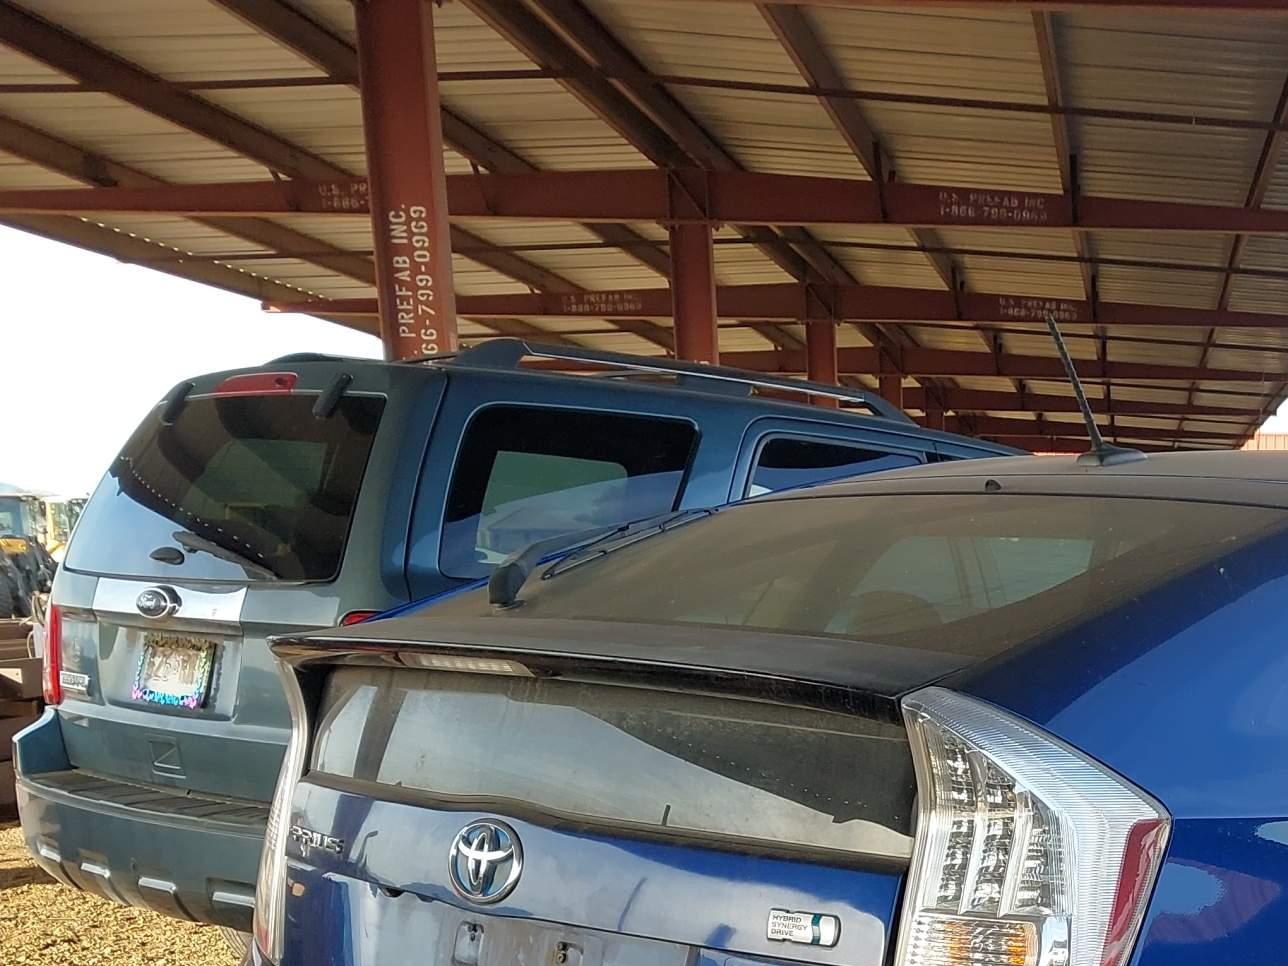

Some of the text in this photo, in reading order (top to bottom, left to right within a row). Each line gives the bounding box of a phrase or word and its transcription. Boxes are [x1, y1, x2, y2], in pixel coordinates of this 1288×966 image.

[389, 204, 408, 243] INC.
[392, 256, 417, 337] PREFAB
[772, 914, 802, 923] HYBRID
[771, 920, 808, 931] SYNERGY
[771, 928, 794, 937] DRIVE
